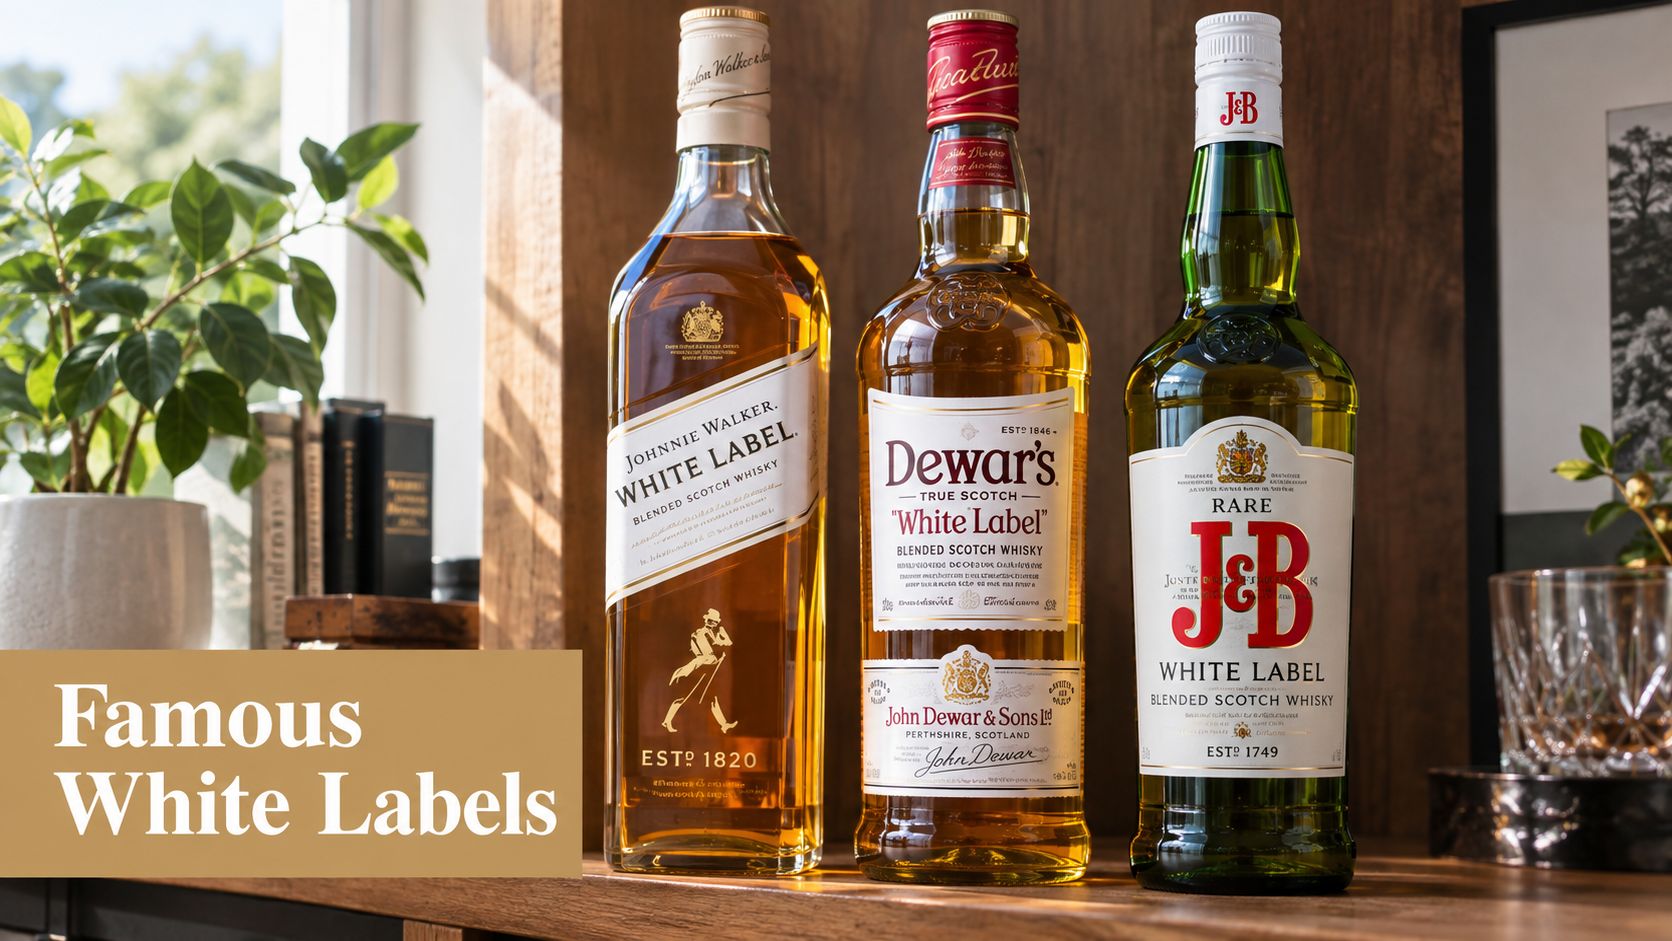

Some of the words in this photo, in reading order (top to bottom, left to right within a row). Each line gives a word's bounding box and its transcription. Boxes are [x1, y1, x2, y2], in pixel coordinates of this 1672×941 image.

[1220, 91, 1258, 126] J&B
[625, 430, 700, 474] JOHNNIE
[614, 456, 703, 509] WHITE
[632, 498, 683, 526] BLENDED
[687, 478, 731, 503] SCOTCH
[734, 458, 779, 483] WHISKY
[920, 491, 955, 501] TRUE
[961, 491, 1018, 501] SCOTCH
[1212, 498, 1273, 513] RARE
[897, 545, 944, 556] BLENDED
[949, 545, 996, 556] SCOTCH
[1000, 545, 1043, 556] WHISKY
[1171, 521, 1314, 649] J&B
[1159, 661, 1240, 681] WHITE
[1252, 662, 1325, 682] LABEL
[1151, 694, 1208, 706] BLENDED
[1215, 694, 1280, 706] SCOTCH
[1286, 694, 1334, 706] WHISKY
[885, 706, 920, 727] John
[923, 706, 981, 726] Dewar
[984, 710, 996, 726] &
[999, 707, 1038, 726] Sons
[906, 731, 971, 740] PERTHSHIRE,
[975, 731, 1030, 739] SCOTLAND
[704, 751, 757, 768] 1820
[914, 746, 970, 778] John
[967, 743, 1037, 766] Dewar
[1246, 746, 1279, 758] 1749
